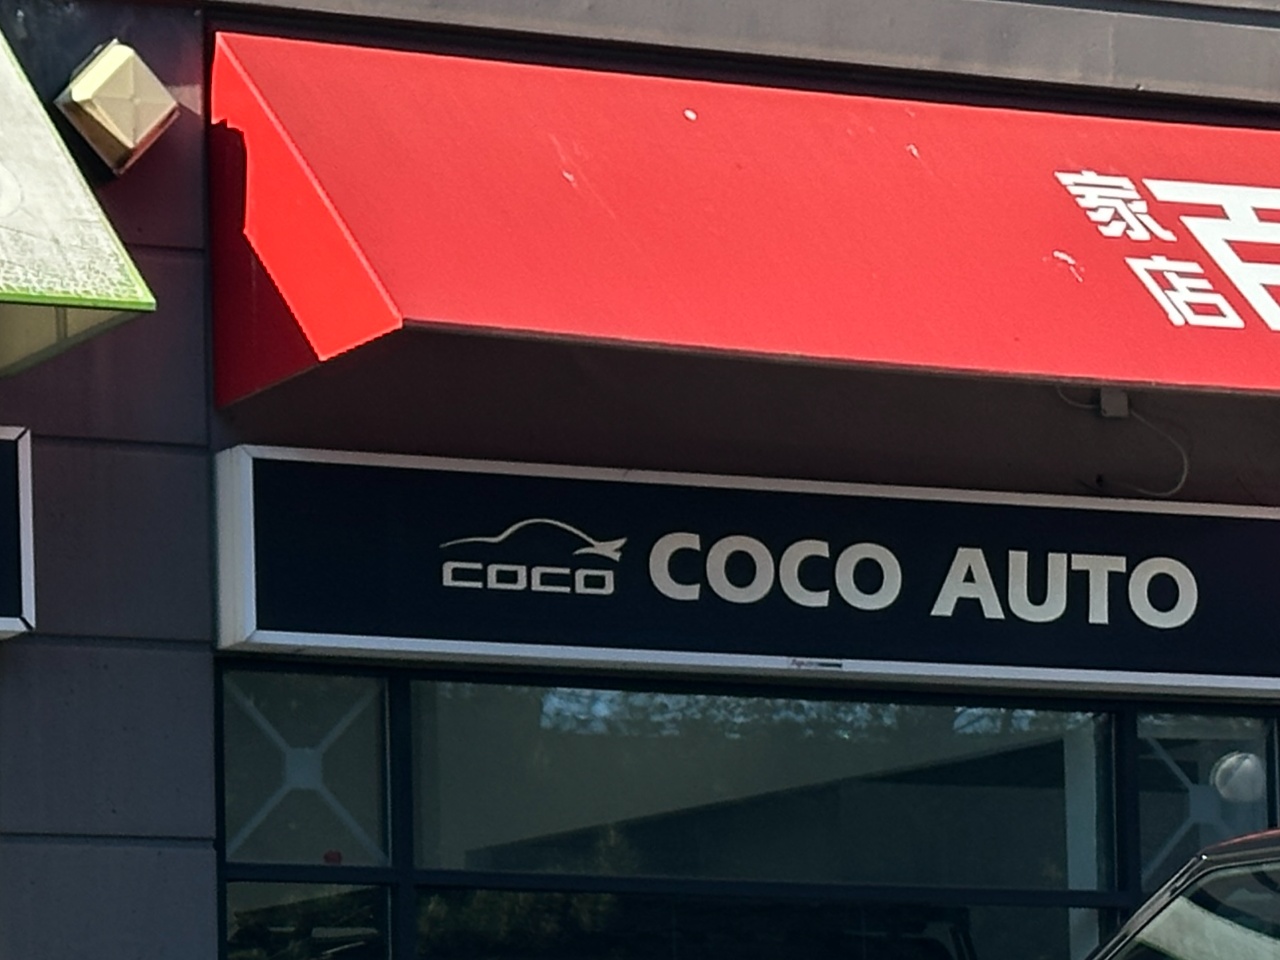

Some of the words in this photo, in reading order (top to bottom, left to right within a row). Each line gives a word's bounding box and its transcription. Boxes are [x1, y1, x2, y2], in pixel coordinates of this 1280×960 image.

[441, 560, 615, 596] COCO
[649, 532, 902, 611] COCO
[930, 546, 1199, 629] AUTO
